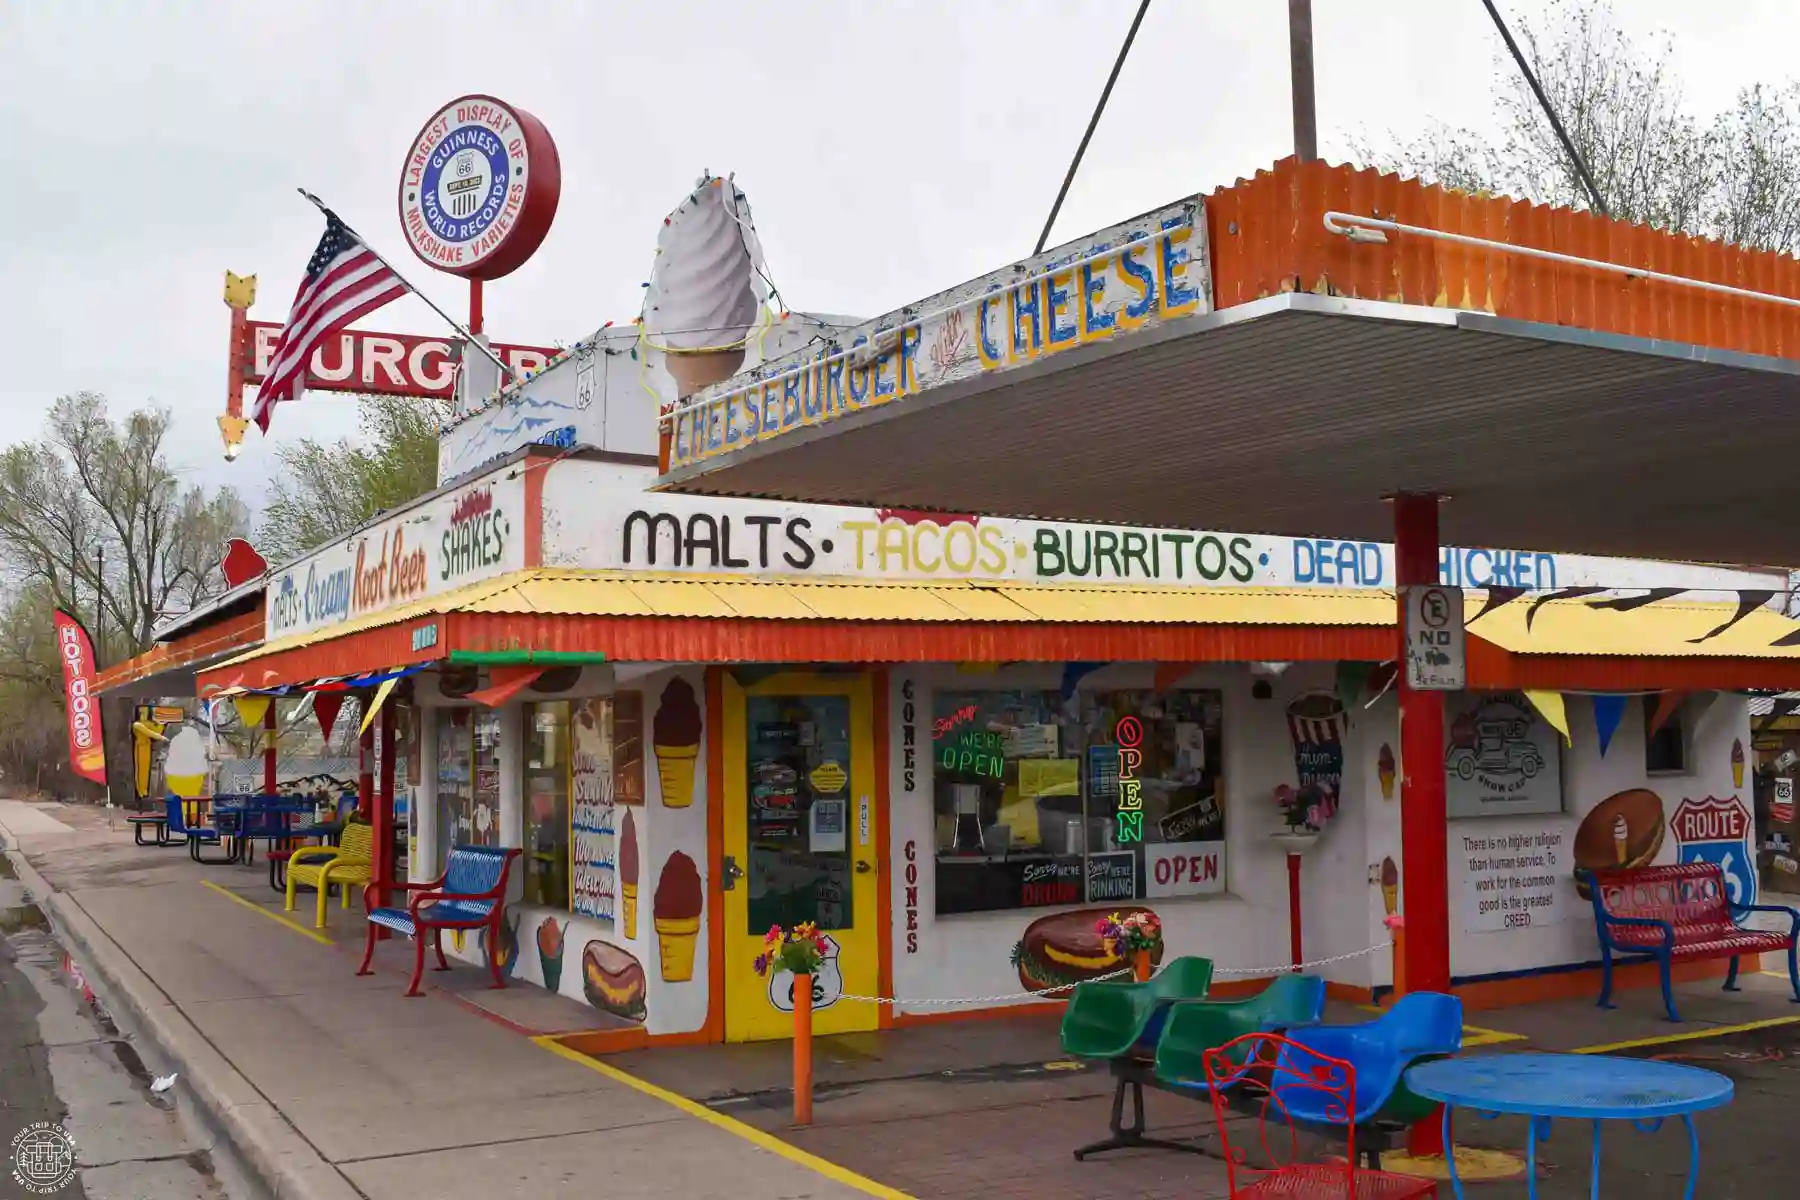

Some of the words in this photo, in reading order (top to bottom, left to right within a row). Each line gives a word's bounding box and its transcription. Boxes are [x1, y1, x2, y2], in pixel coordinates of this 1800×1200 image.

[407, 117, 448, 186] LARGEST
[457, 105, 512, 133] DISPLAY
[508, 138, 524, 159] OF
[433, 130, 499, 169] GUINNESS
[459, 163, 471, 174] 66
[424, 190, 456, 238] WORLD
[460, 174, 505, 238] RECORDS
[407, 207, 463, 262] MILKSHAKE
[471, 183, 524, 257] VARIETIES
[672, 323, 922, 466] CHEESEBURGER
[975, 216, 1201, 370] CHEESE
[304, 560, 352, 623] Creamy
[353, 528, 389, 612] Root
[389, 523, 427, 597] Beer
[441, 508, 503, 581] SHAKES
[622, 508, 815, 569] MALTS
[842, 520, 1006, 575] TACOS
[1034, 528, 1254, 582] BURRITOS
[1293, 539, 1383, 587] DEAD
[1439, 547, 1556, 592] HICKEN
[60, 624, 83, 676] HOT
[1420, 630, 1450, 645] NO
[70, 677, 93, 748] DOGS
[902, 679, 916, 792] CONES
[943, 747, 1004, 778] OPEN
[1116, 716, 1143, 842] OPEN
[1778, 788, 1789, 797] 66
[861, 804, 869, 837] PULL
[1684, 810, 1740, 839] ROUTE
[1464, 836, 1487, 851] There
[1488, 837, 1495, 849] is
[1497, 838, 1507, 849] no
[1508, 834, 1532, 851] higher
[1535, 832, 1562, 849] religion
[1057, 865, 1080, 877] WE'RE
[1154, 854, 1218, 885] OPEN
[1469, 857, 1487, 871] than
[1489, 856, 1515, 870] human
[1548, 852, 1556, 865] To
[904, 840, 918, 953] CONES
[1090, 878, 1132, 899] RINKING
[1476, 879, 1495, 891] work
[1497, 876, 1507, 889] for
[1509, 875, 1520, 888] the
[1522, 874, 1555, 888] common
[1479, 896, 1500, 914] good
[1501, 896, 1508, 909] is
[1509, 895, 1521, 908] the
[1523, 893, 1553, 911] greatest
[1504, 913, 1531, 928] CREED
